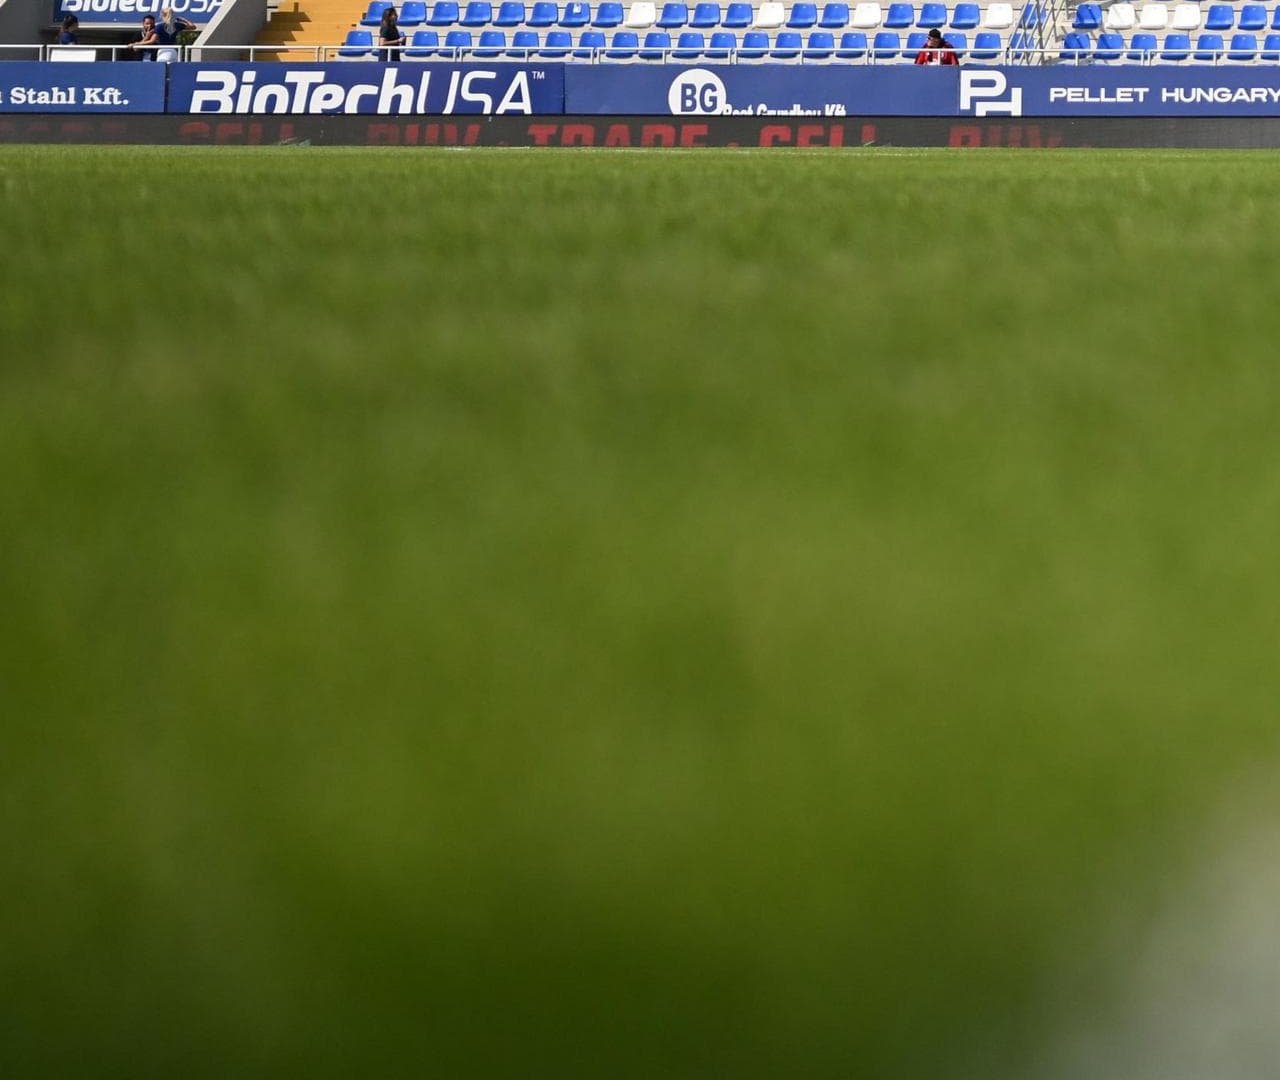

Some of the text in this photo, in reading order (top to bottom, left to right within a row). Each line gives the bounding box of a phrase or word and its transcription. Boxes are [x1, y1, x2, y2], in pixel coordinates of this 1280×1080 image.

[11, 87, 76, 105] Stahl
[83, 87, 129, 105] Kft.
[189, 68, 532, 114] BioTechUSA
[680, 83, 718, 113] BG
[1049, 87, 1149, 103] PELLET
